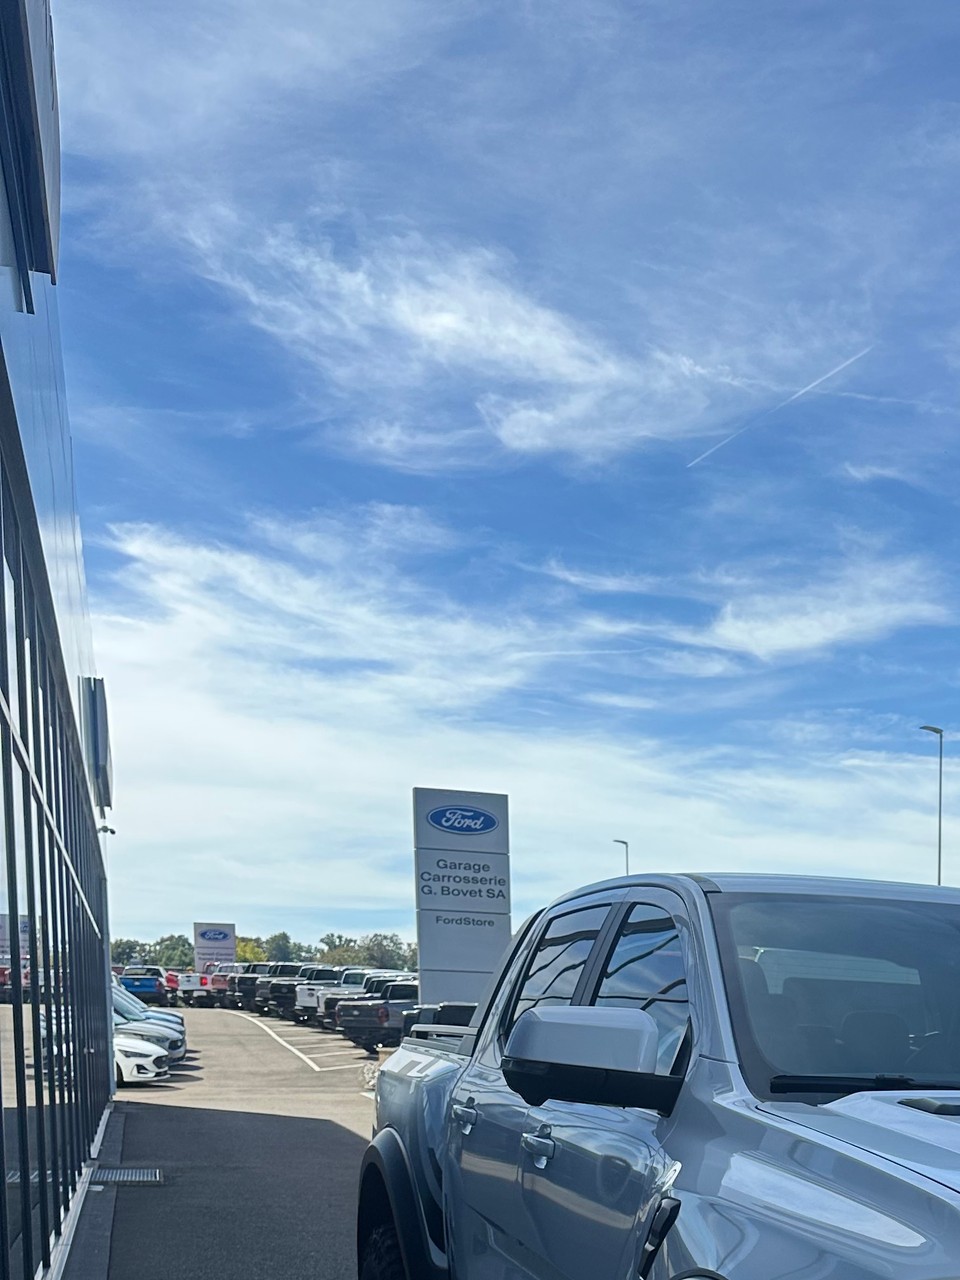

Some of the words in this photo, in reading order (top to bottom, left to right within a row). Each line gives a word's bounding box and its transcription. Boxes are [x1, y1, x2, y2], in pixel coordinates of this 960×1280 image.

[442, 809, 484, 830] Ford
[436, 859, 491, 873] Garage
[420, 871, 506, 886] Carrosserie
[420, 884, 437, 896] G.
[441, 886, 484, 898] Bovet
[486, 888, 506, 899] SA
[435, 915, 495, 928] FordStore
